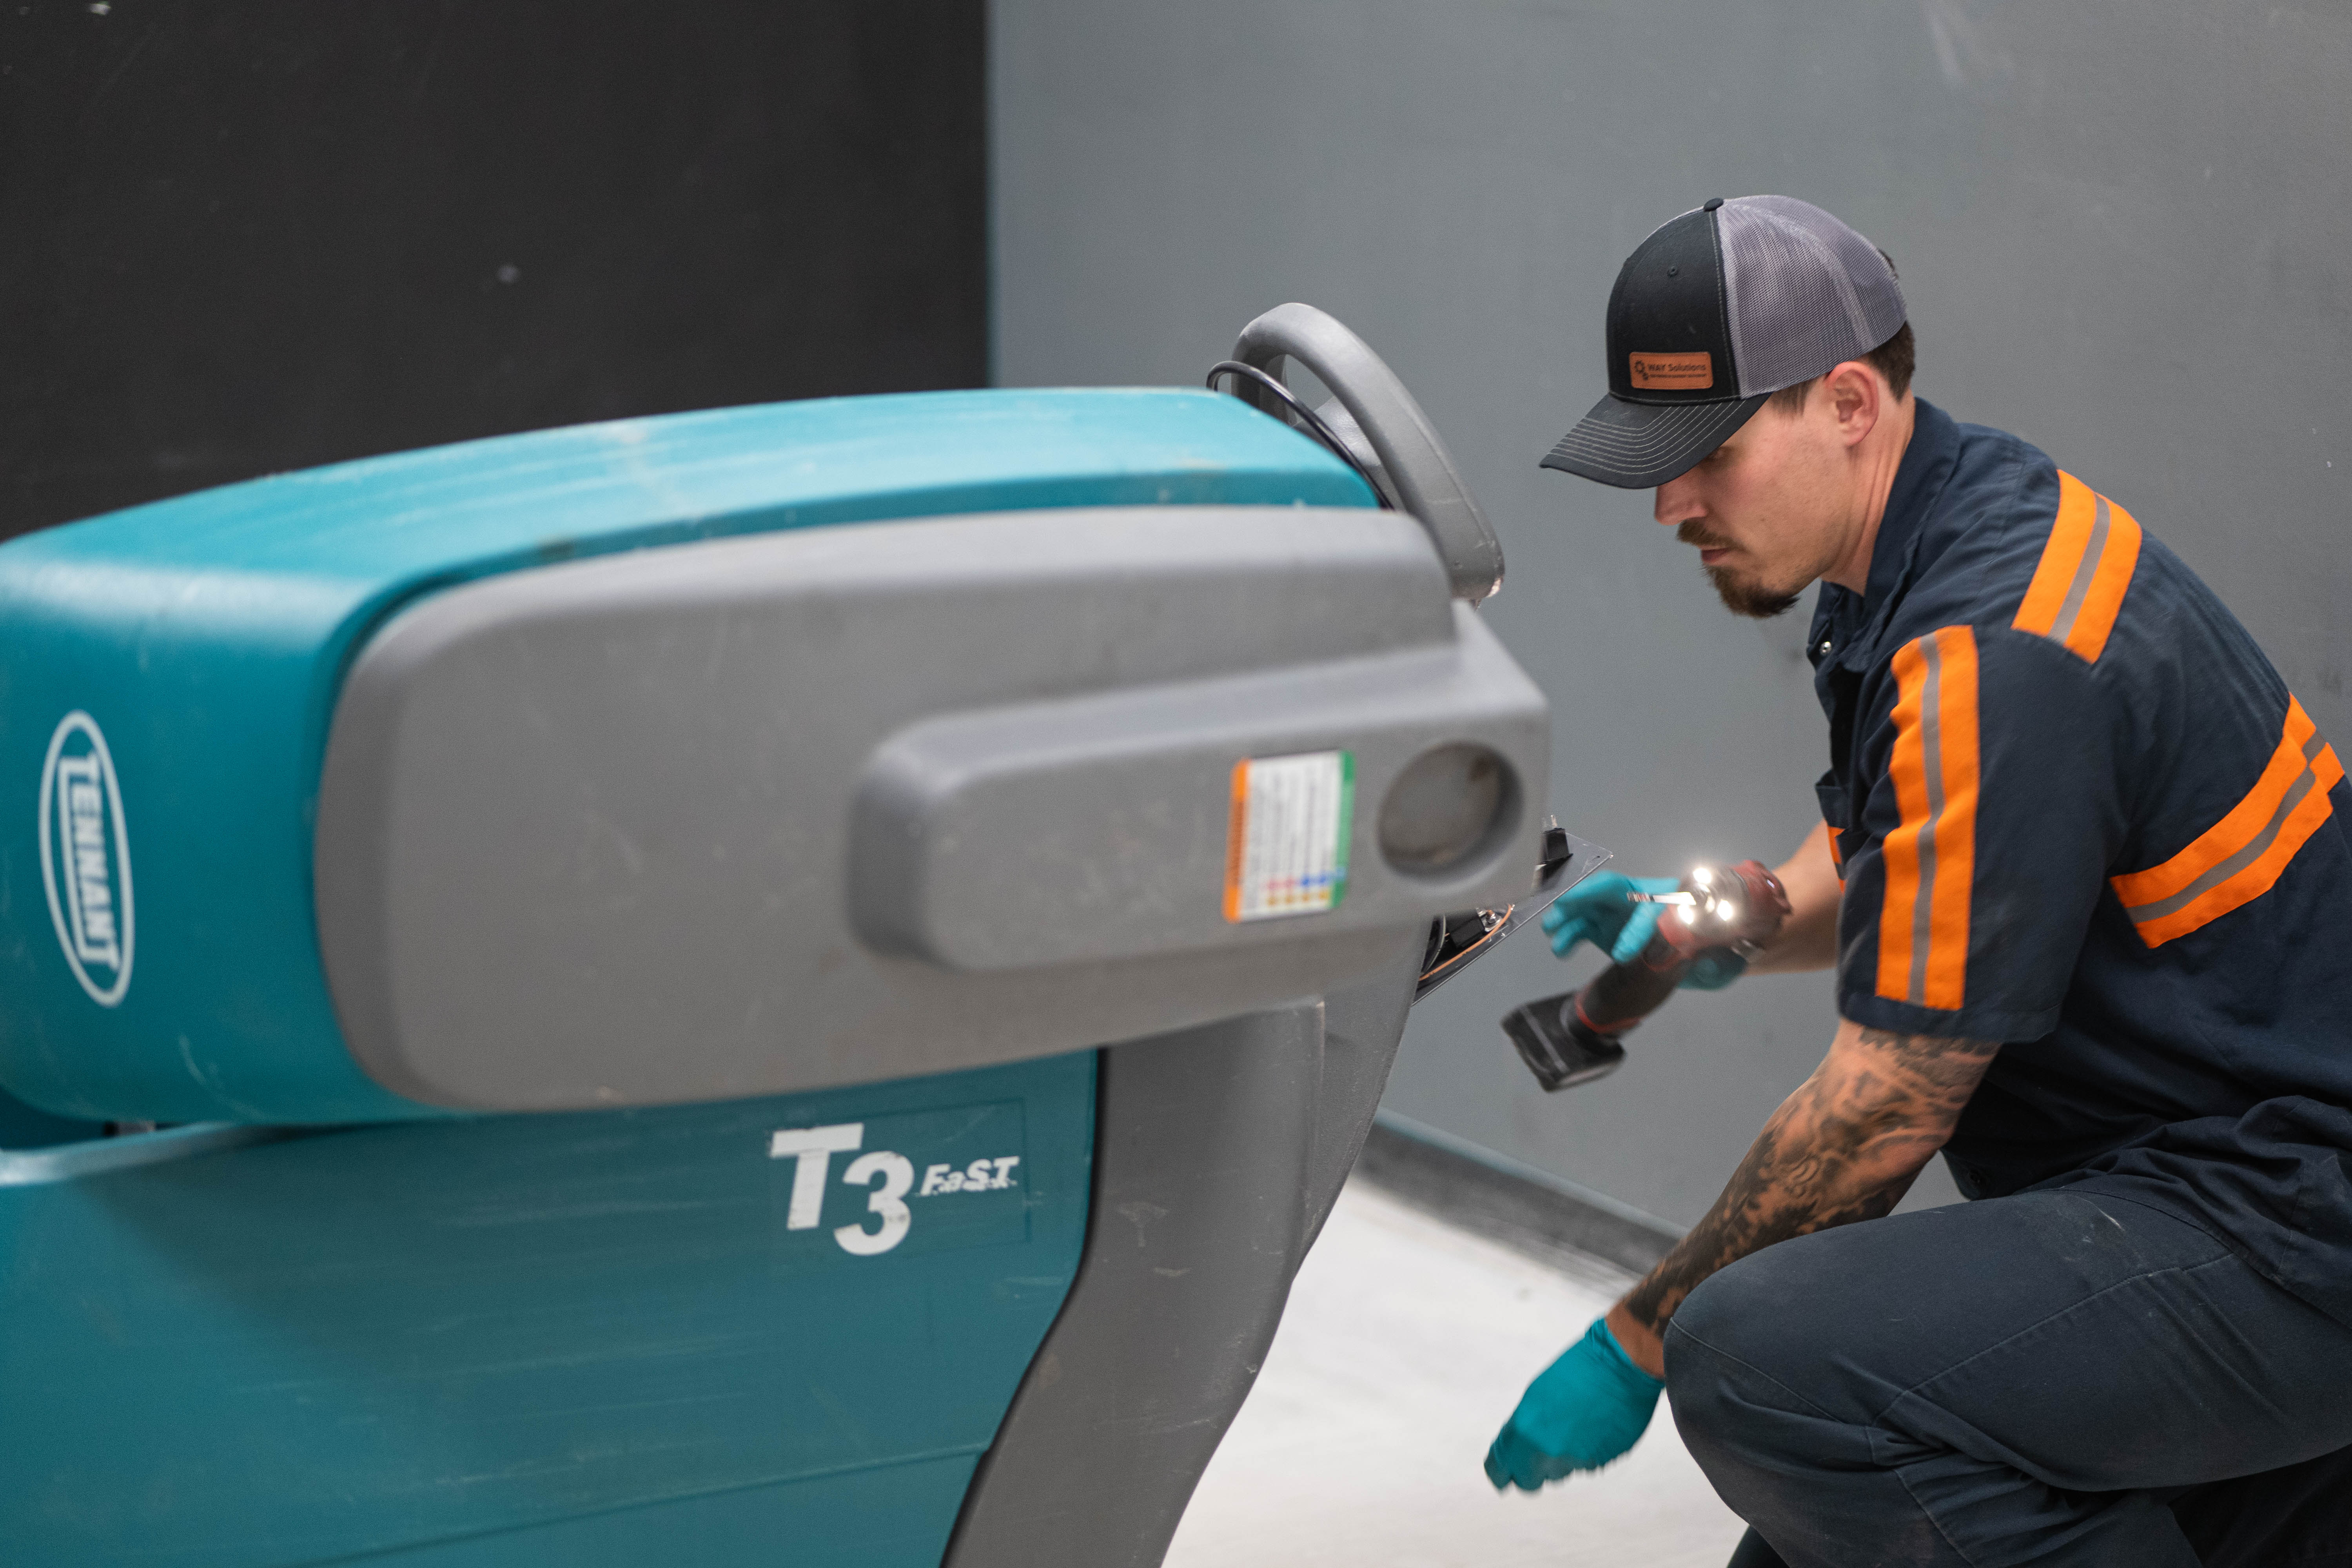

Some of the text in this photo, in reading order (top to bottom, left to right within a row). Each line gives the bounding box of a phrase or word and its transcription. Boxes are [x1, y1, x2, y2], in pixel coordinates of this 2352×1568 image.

[1668, 363, 1706, 371] Solutions
[57, 750, 121, 972] TENNANT
[769, 1122, 914, 1256] T3
